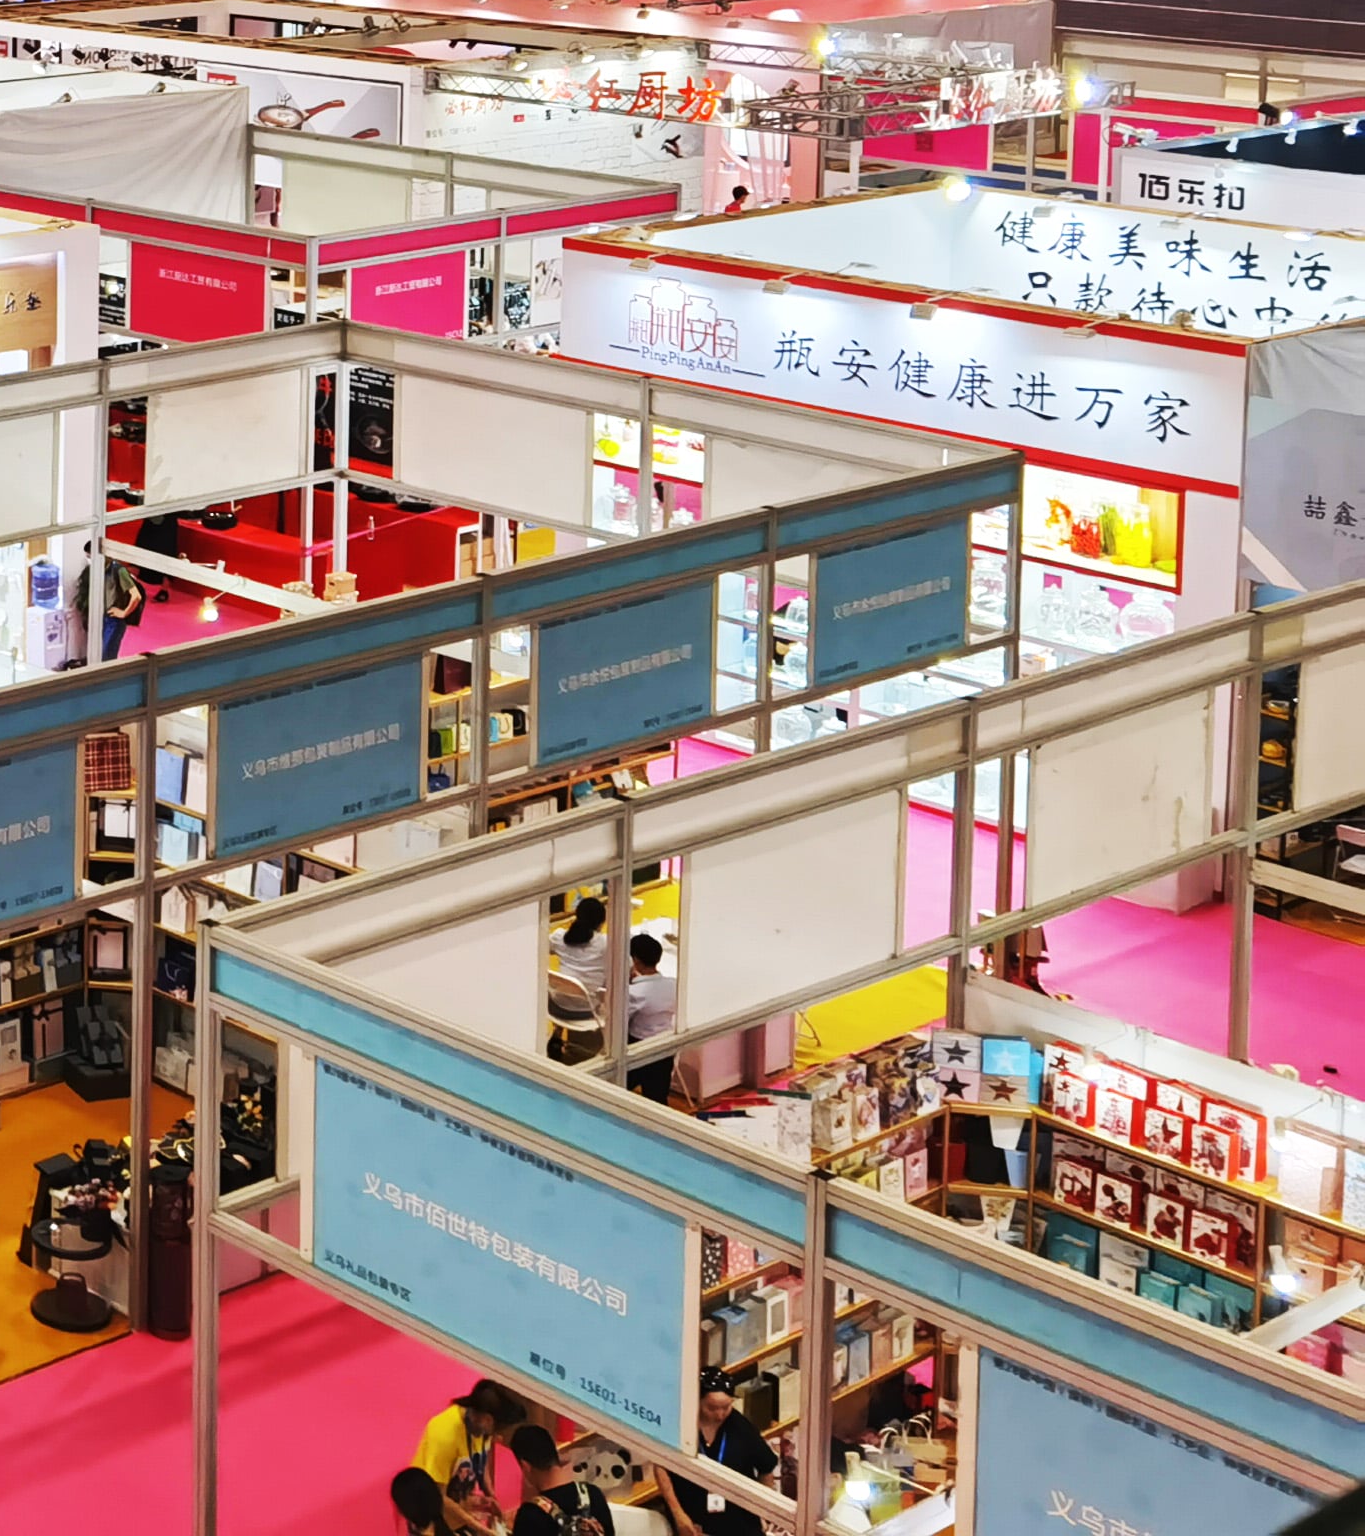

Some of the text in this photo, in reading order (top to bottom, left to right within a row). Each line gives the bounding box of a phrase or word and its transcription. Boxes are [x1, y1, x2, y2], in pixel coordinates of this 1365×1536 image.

[1139, 172, 1247, 212] 佰乐扣
[995, 210, 1333, 292] 健康美味生活
[1022, 270, 1351, 332] 只款待心中
[640, 345, 732, 374] PingPingAnAn
[772, 329, 1192, 444] 瓶安健康进万家
[1303, 493, 1365, 527] 喆鑫
[361, 1170, 629, 1318] 义乌市佰世特包装有限公司
[579, 1375, 663, 1428] 15E01-15E04
[1045, 1488, 1153, 1536] 义乌市
